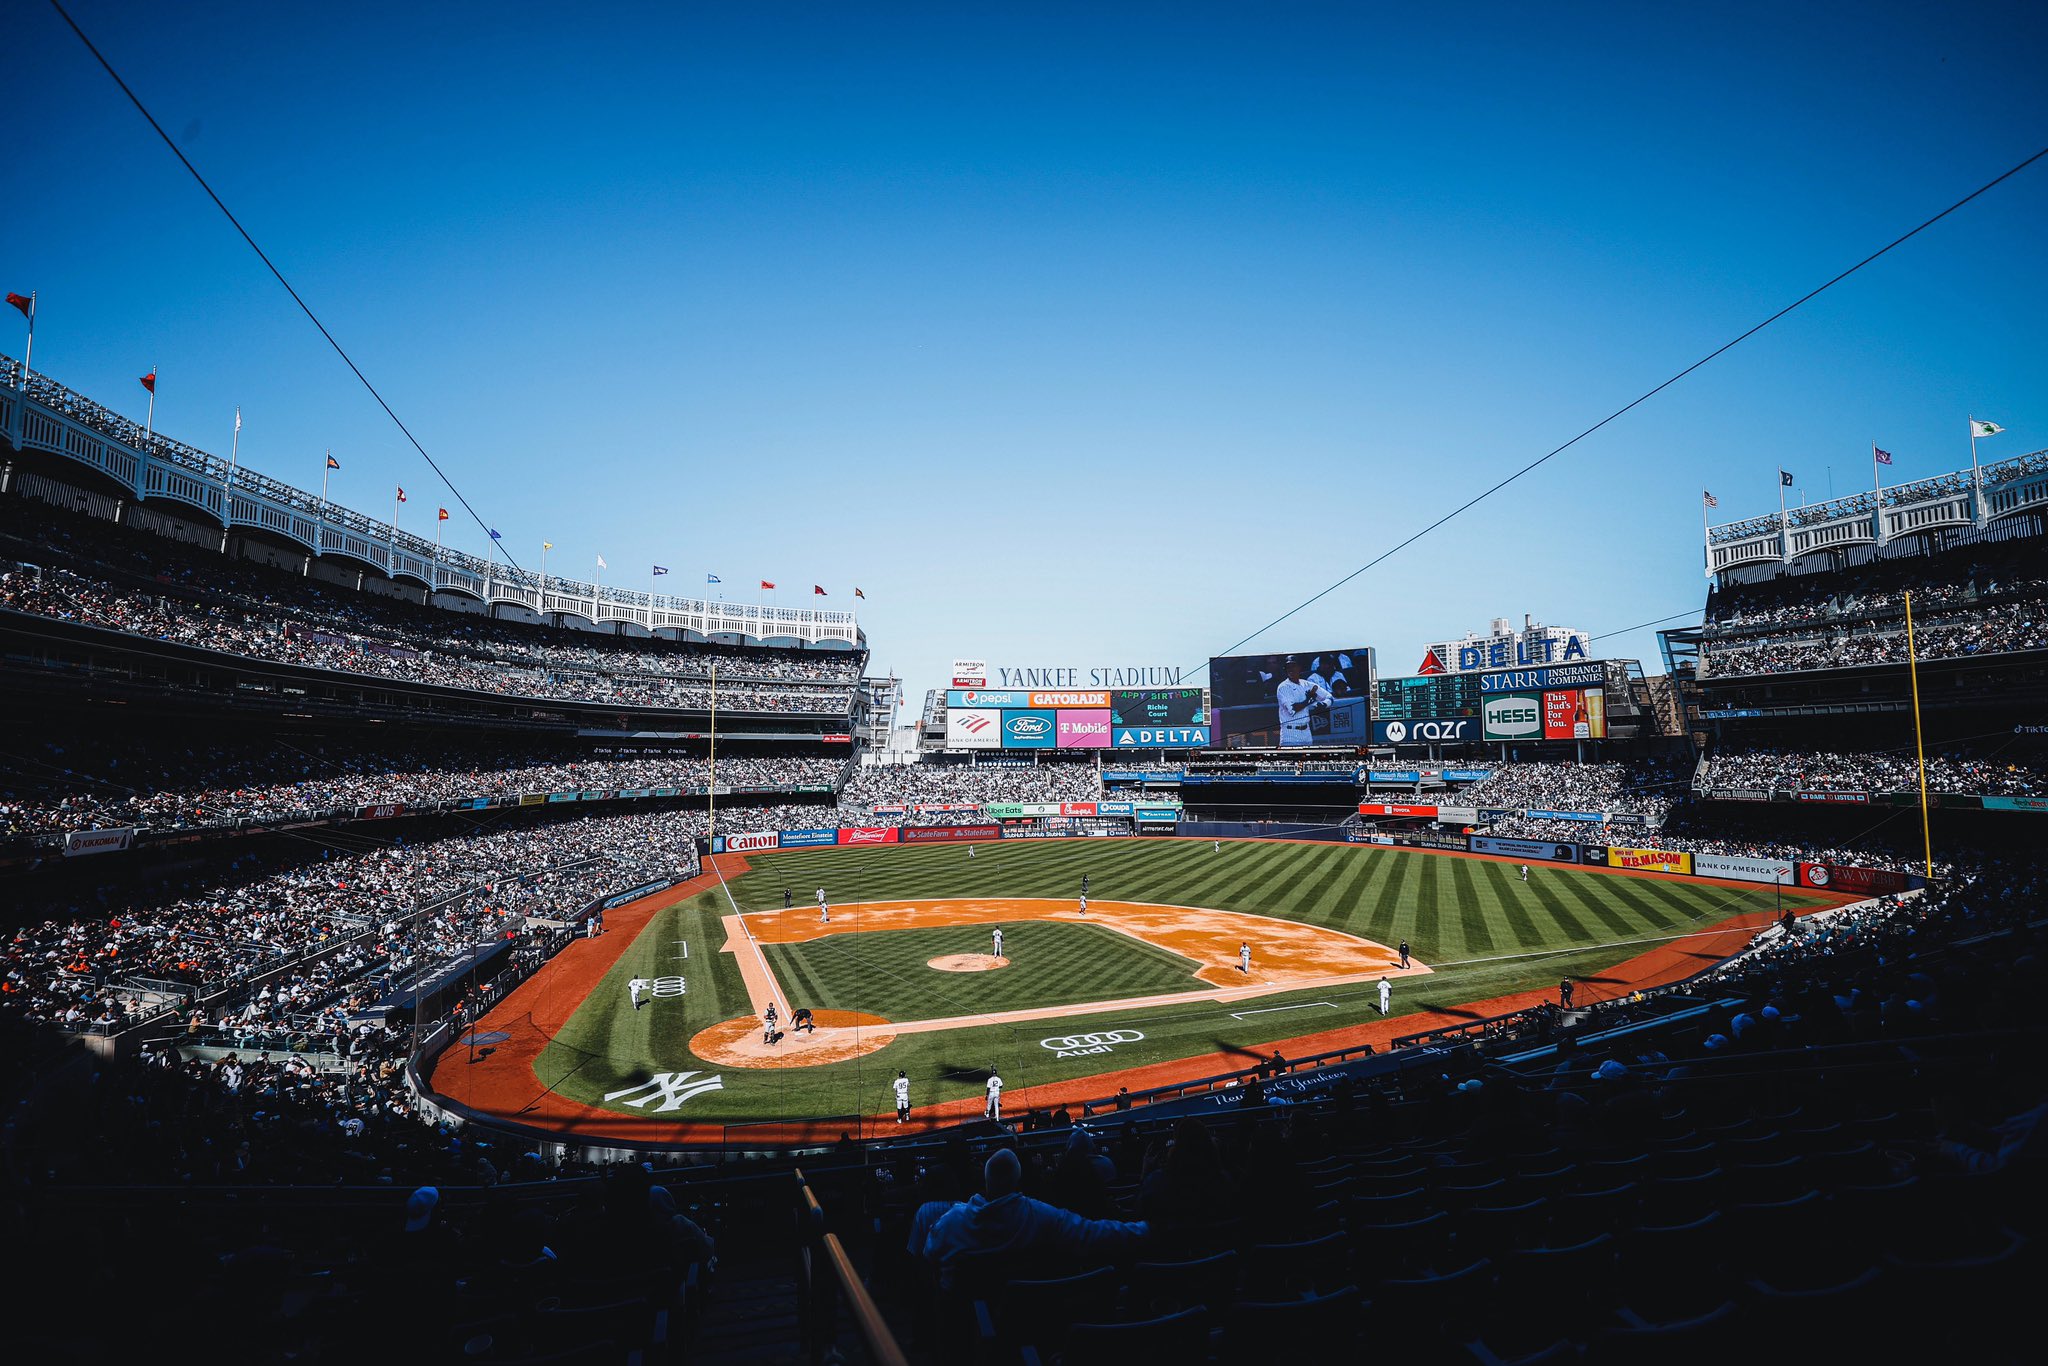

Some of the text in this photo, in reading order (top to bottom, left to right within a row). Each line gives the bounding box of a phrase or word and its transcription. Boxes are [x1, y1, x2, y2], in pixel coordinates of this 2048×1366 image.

[1460, 635, 1586, 670] DELTA
[998, 667, 1181, 686] YANKEE STADIUM
[1548, 664, 1604, 678] INSURANCE
[1481, 671, 1542, 690] STARR
[1548, 673, 1604, 686] COMPANIES
[980, 694, 1012, 704] pepsi
[1034, 694, 1106, 704] GATORADE
[1115, 688, 1200, 700] HAPPY BIRTHDAY
[1488, 708, 1536, 724] HESS
[1014, 720, 1043, 731] Ford
[1072, 722, 1107, 733] Mobile
[1413, 721, 1467, 740] razr
[1140, 730, 1204, 742] DELTA
[1733, 789, 1767, 799] Authority
[373, 806, 395, 817] AVIS
[82, 836, 119, 848] KIKKOMAN
[727, 835, 777, 849] Canon
[1621, 852, 1681, 867] W.B.MASON
[1732, 865, 1771, 874] AMERICA
[1833, 868, 1855, 880] F.W.
[1858, 871, 1895, 885] WEBB
[1056, 1045, 1113, 1058] Audi
[1283, 1070, 1348, 1091] Yankees
